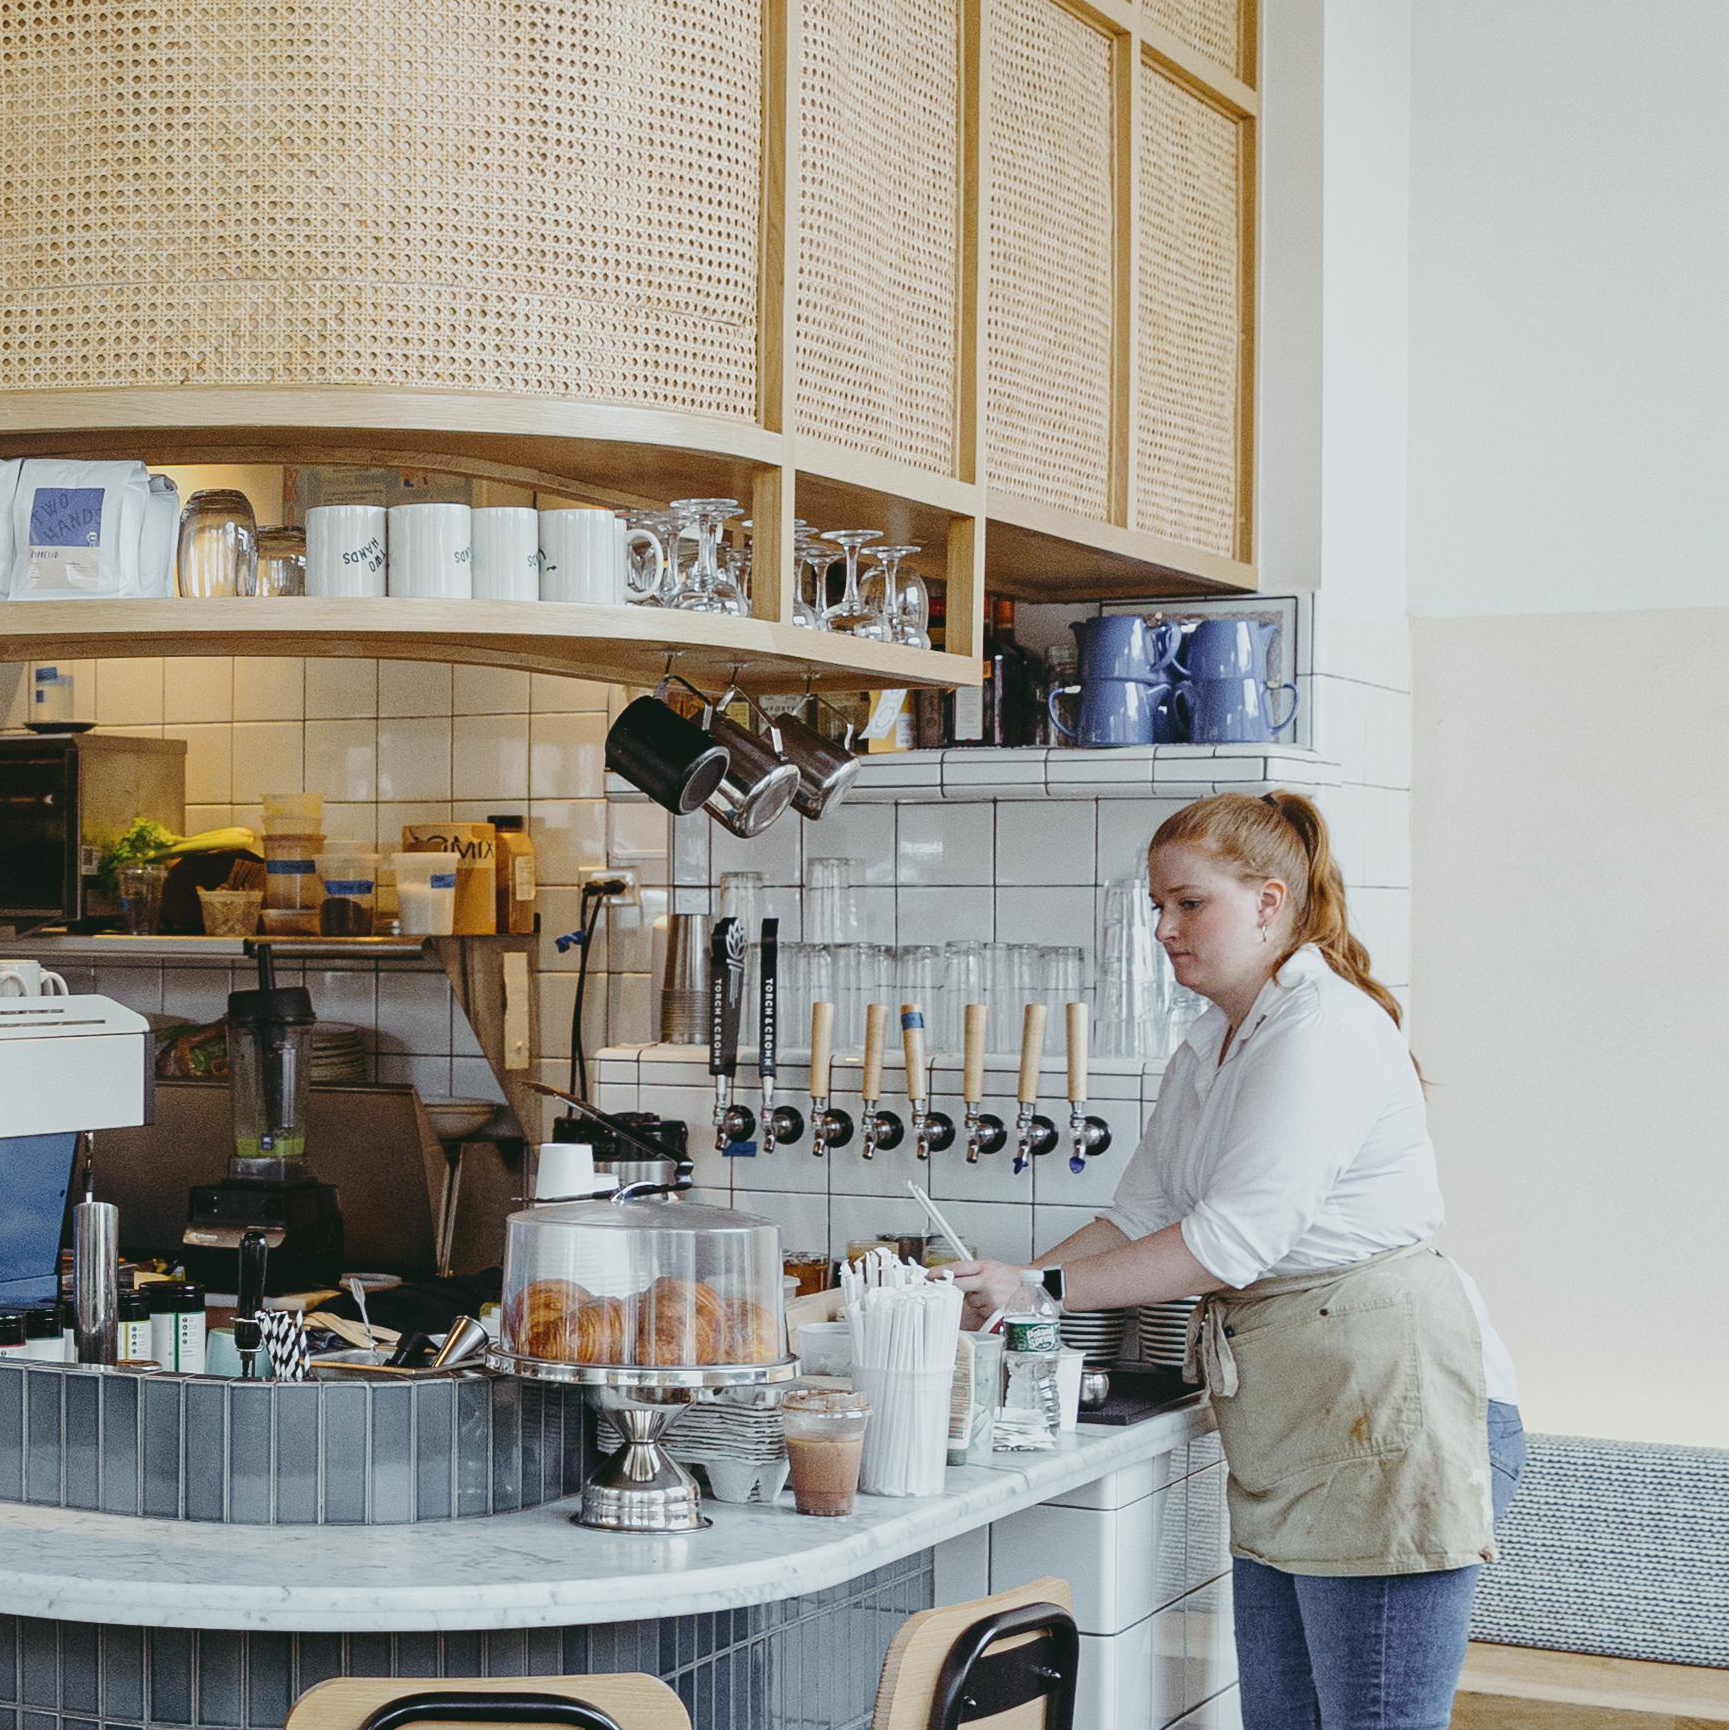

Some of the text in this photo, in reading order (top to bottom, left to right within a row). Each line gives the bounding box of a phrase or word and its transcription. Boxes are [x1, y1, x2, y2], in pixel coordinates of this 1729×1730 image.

[32, 493, 69, 526] TWO
[30, 550, 59, 559] ESPRESSO
[342, 537, 379, 565] HANDS
[368, 550, 386, 573] TWO
[714, 978, 722, 1015] TORCH
[765, 978, 773, 1015] TORCH
